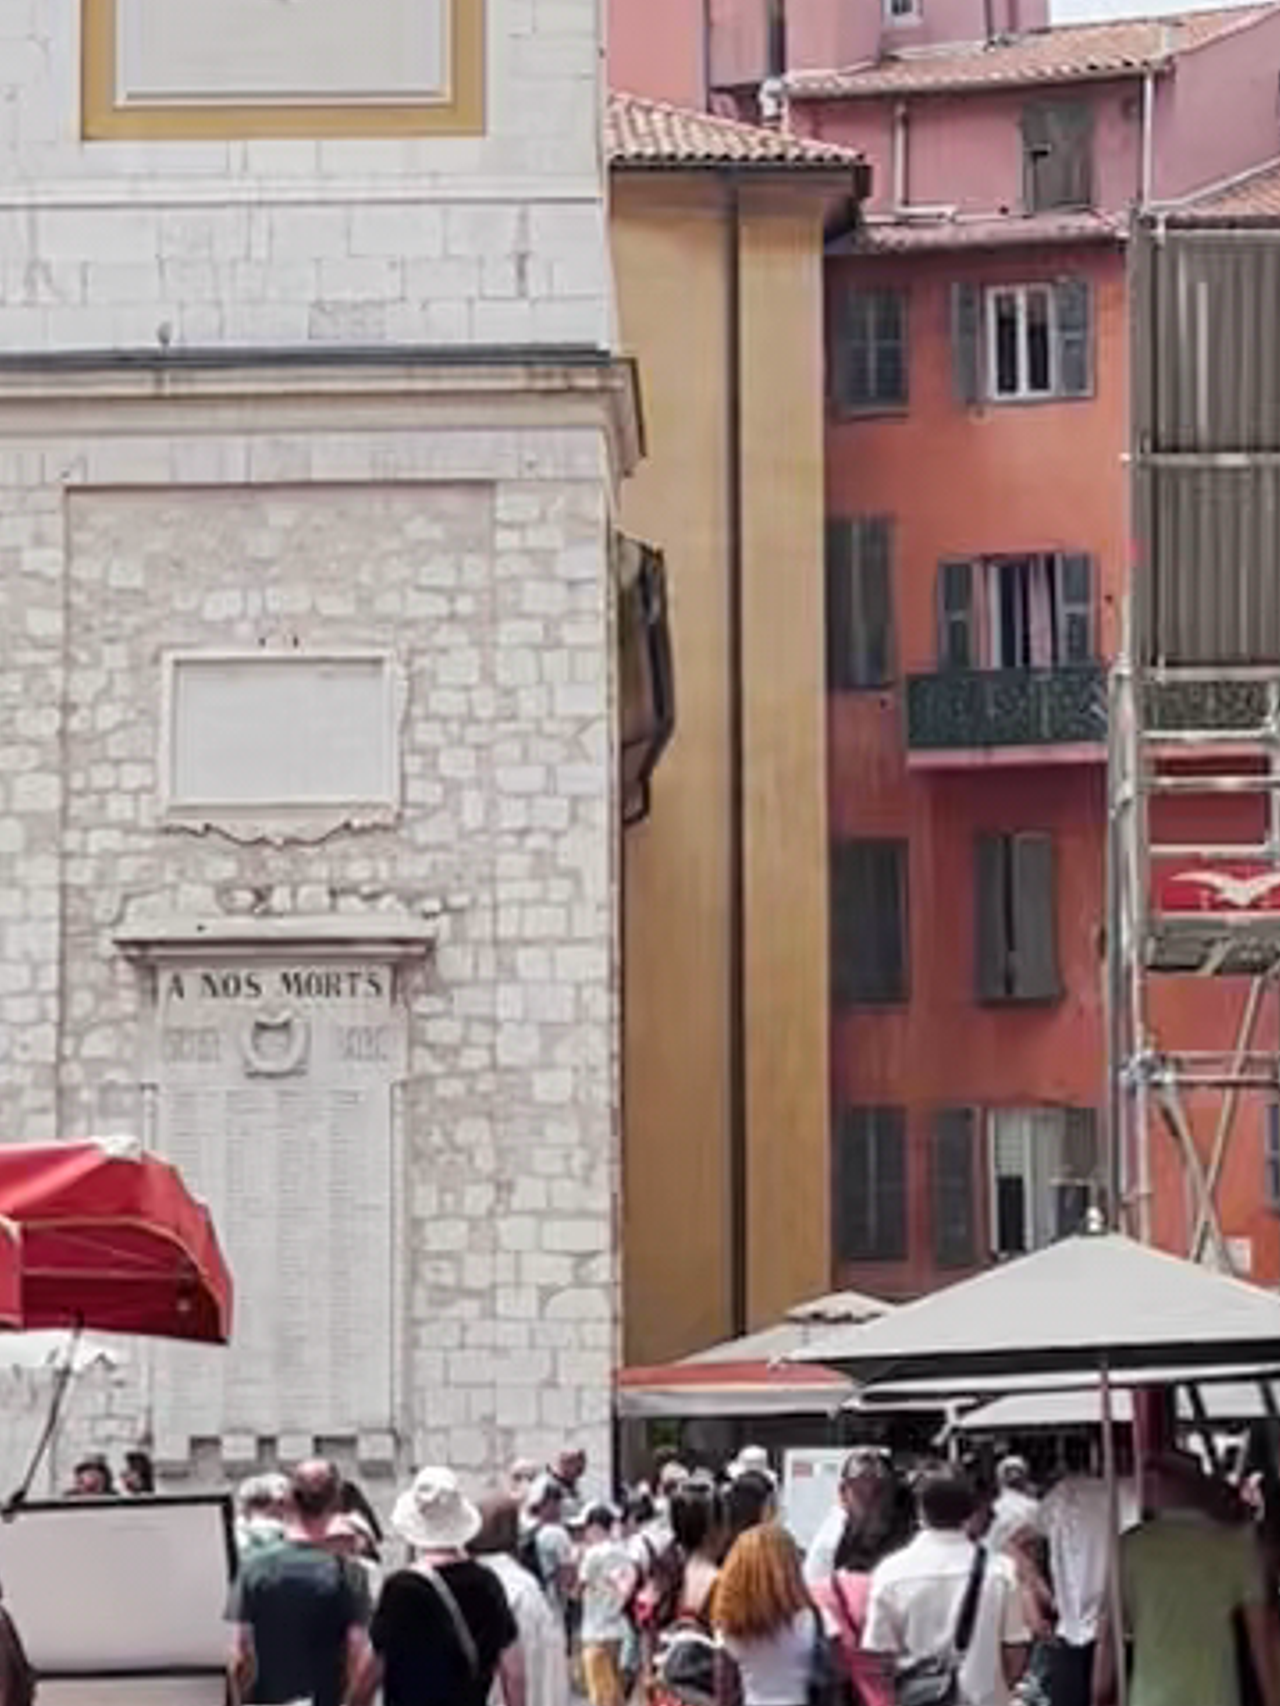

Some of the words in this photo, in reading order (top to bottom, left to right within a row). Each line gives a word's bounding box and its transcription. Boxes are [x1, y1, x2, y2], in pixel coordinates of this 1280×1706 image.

[167, 971, 186, 999] A
[201, 971, 262, 998] NOS
[278, 970, 384, 998] MORTS
